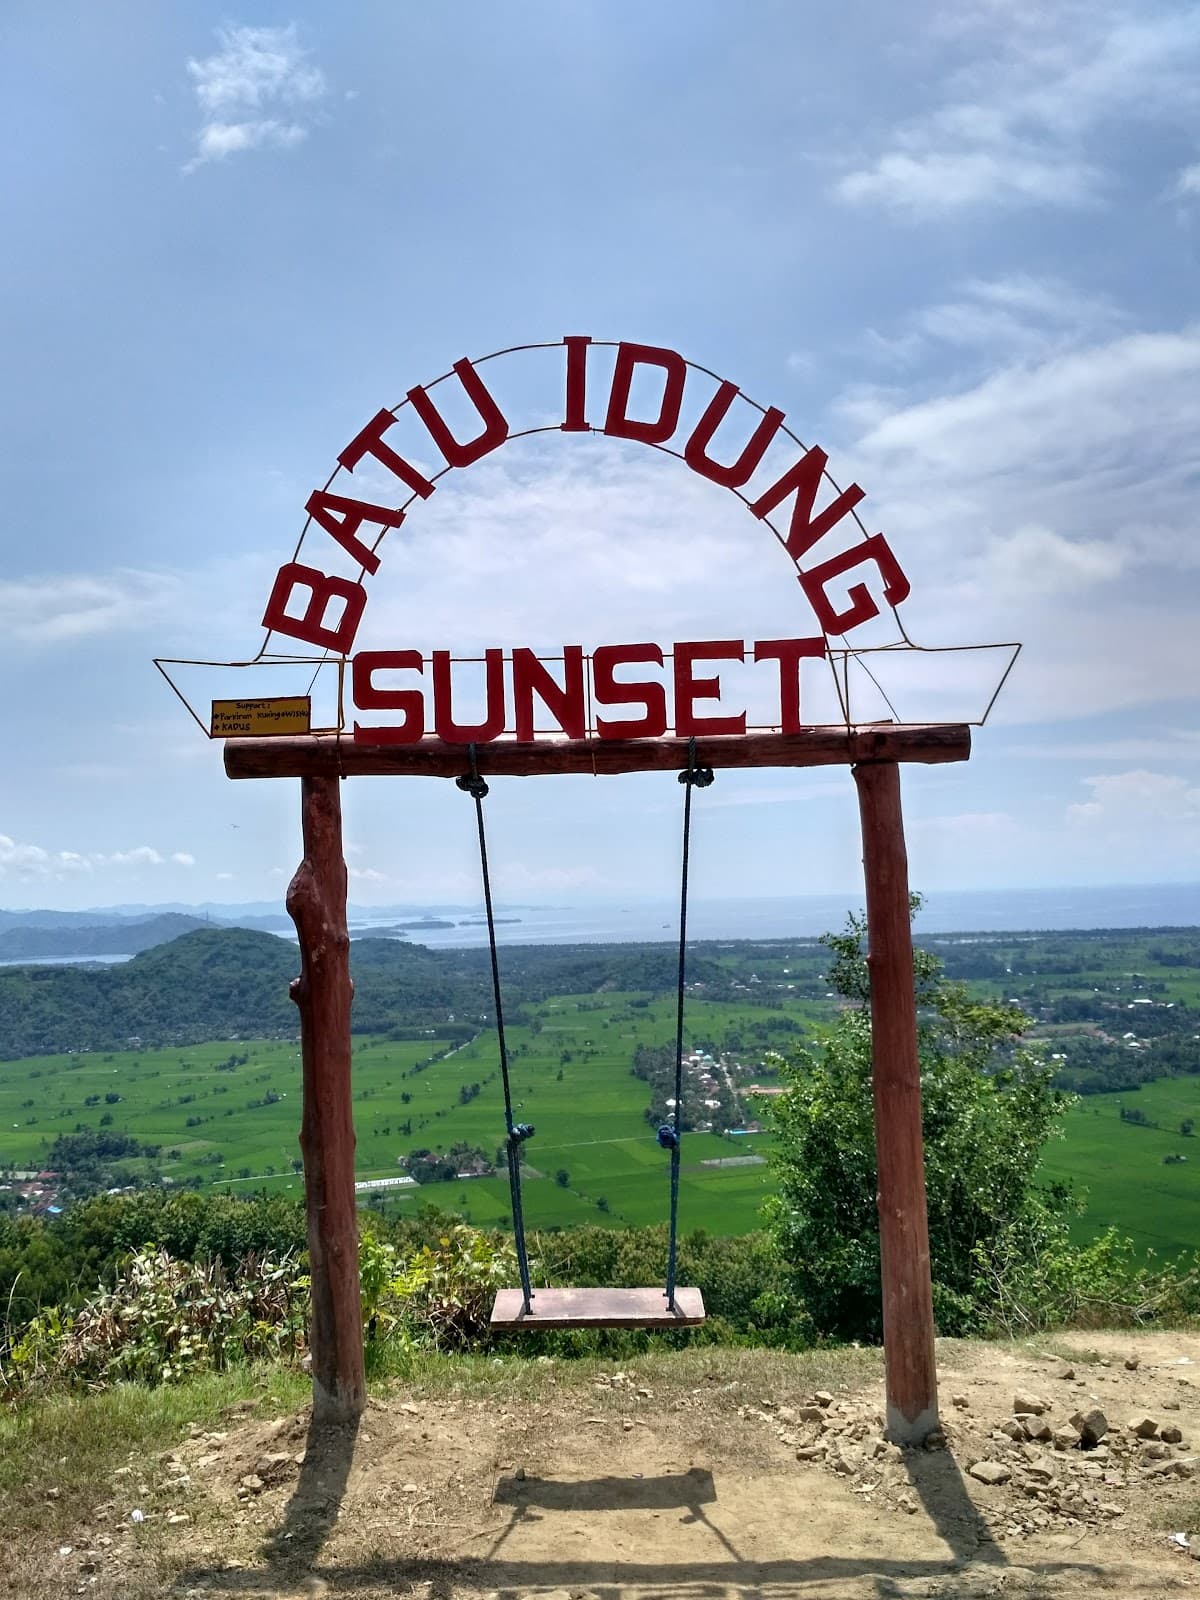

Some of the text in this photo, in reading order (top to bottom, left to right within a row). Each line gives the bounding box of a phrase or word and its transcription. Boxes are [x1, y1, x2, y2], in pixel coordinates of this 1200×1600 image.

[262, 336, 910, 654] BATU IDUNG
[222, 722, 251, 731] KADUS
[353, 637, 826, 744] SUNSET
